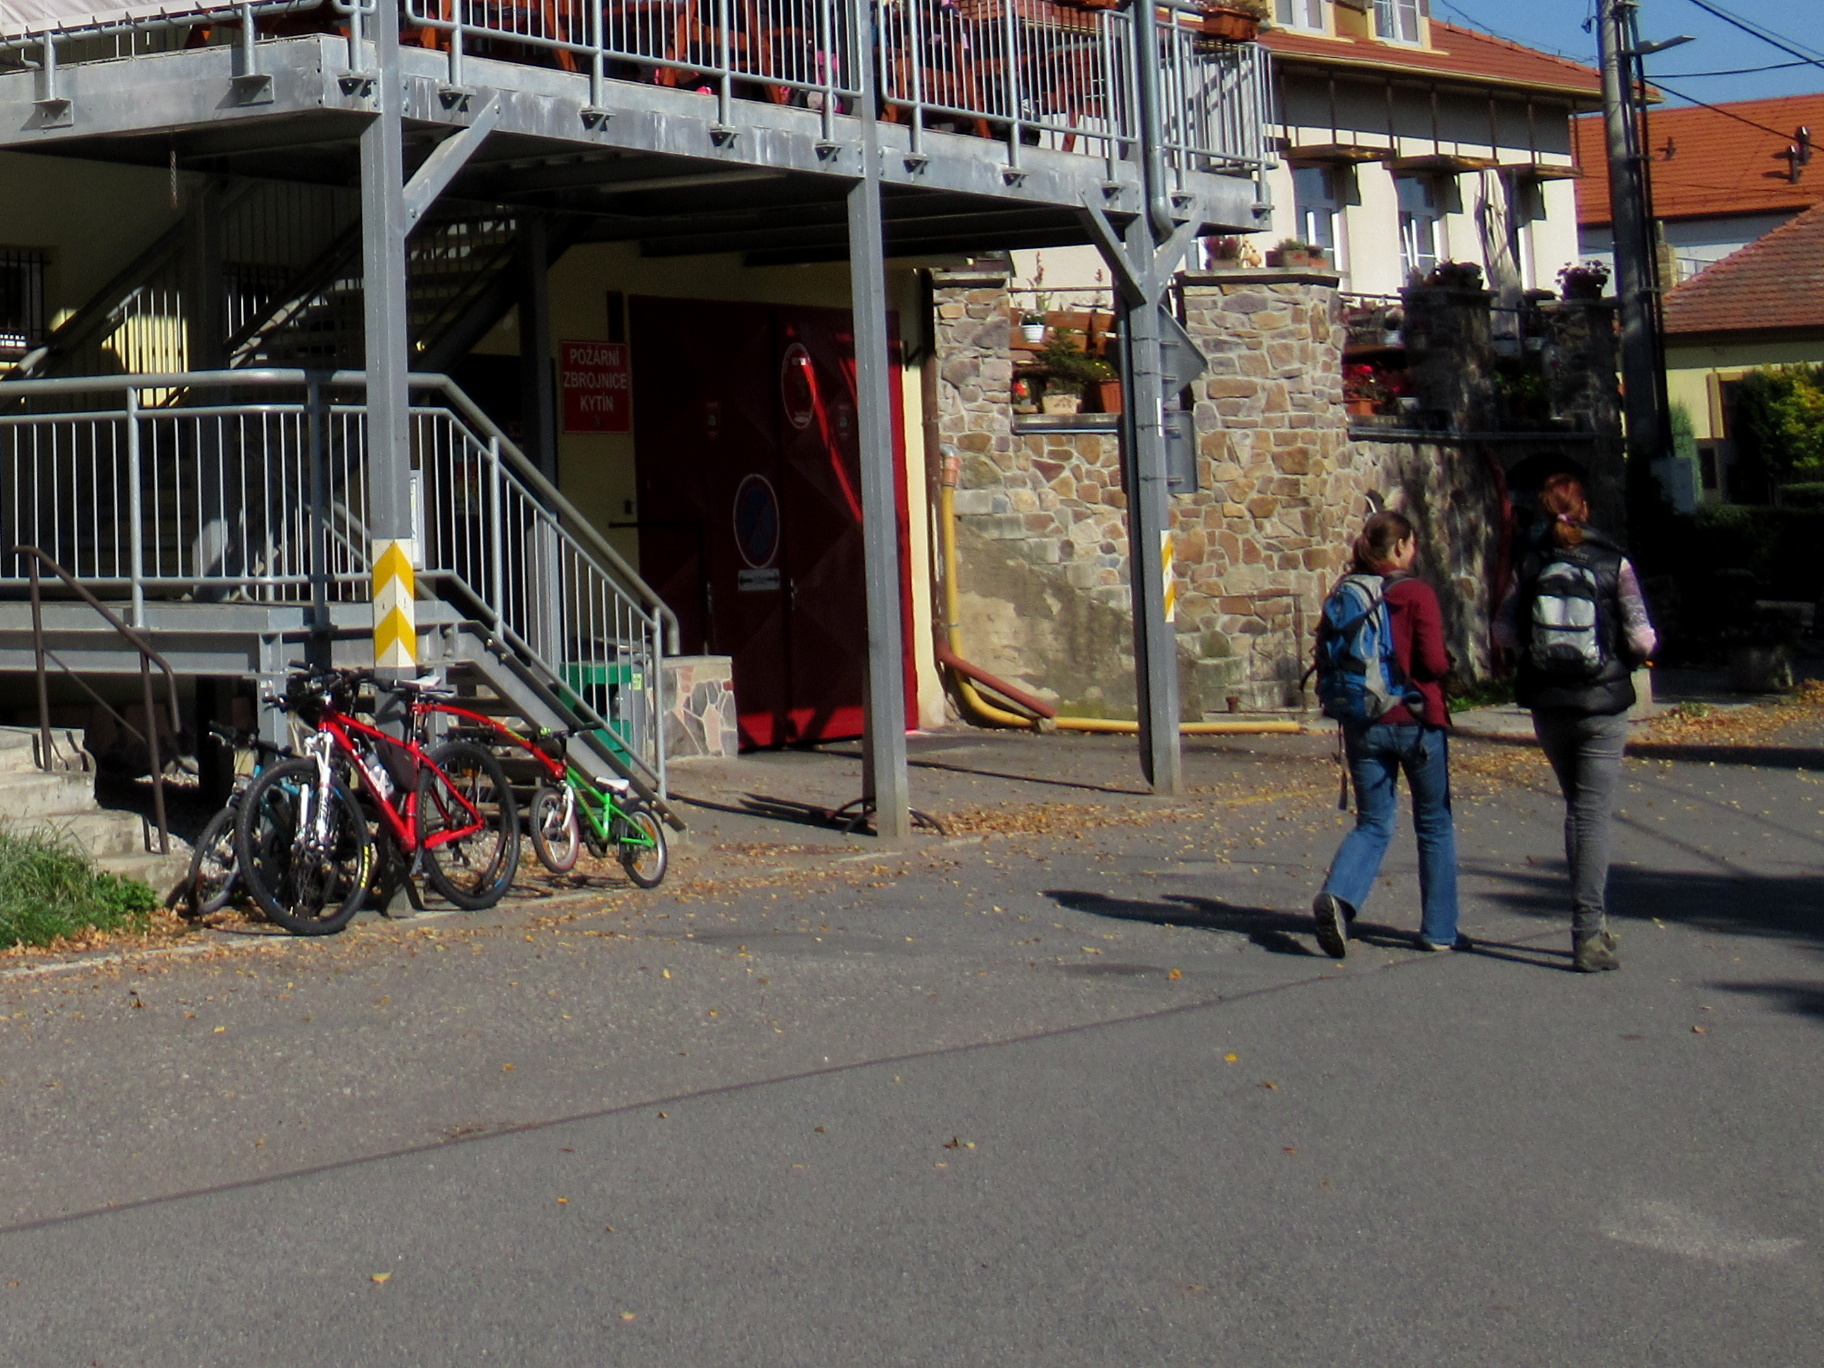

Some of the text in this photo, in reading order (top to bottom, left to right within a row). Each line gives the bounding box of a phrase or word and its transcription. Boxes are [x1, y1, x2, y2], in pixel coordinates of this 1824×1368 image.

[570, 345, 619, 365] POŽÁRNÍ
[563, 371, 628, 389] ZBROJNICE
[581, 392, 613, 411] KYTÍN
